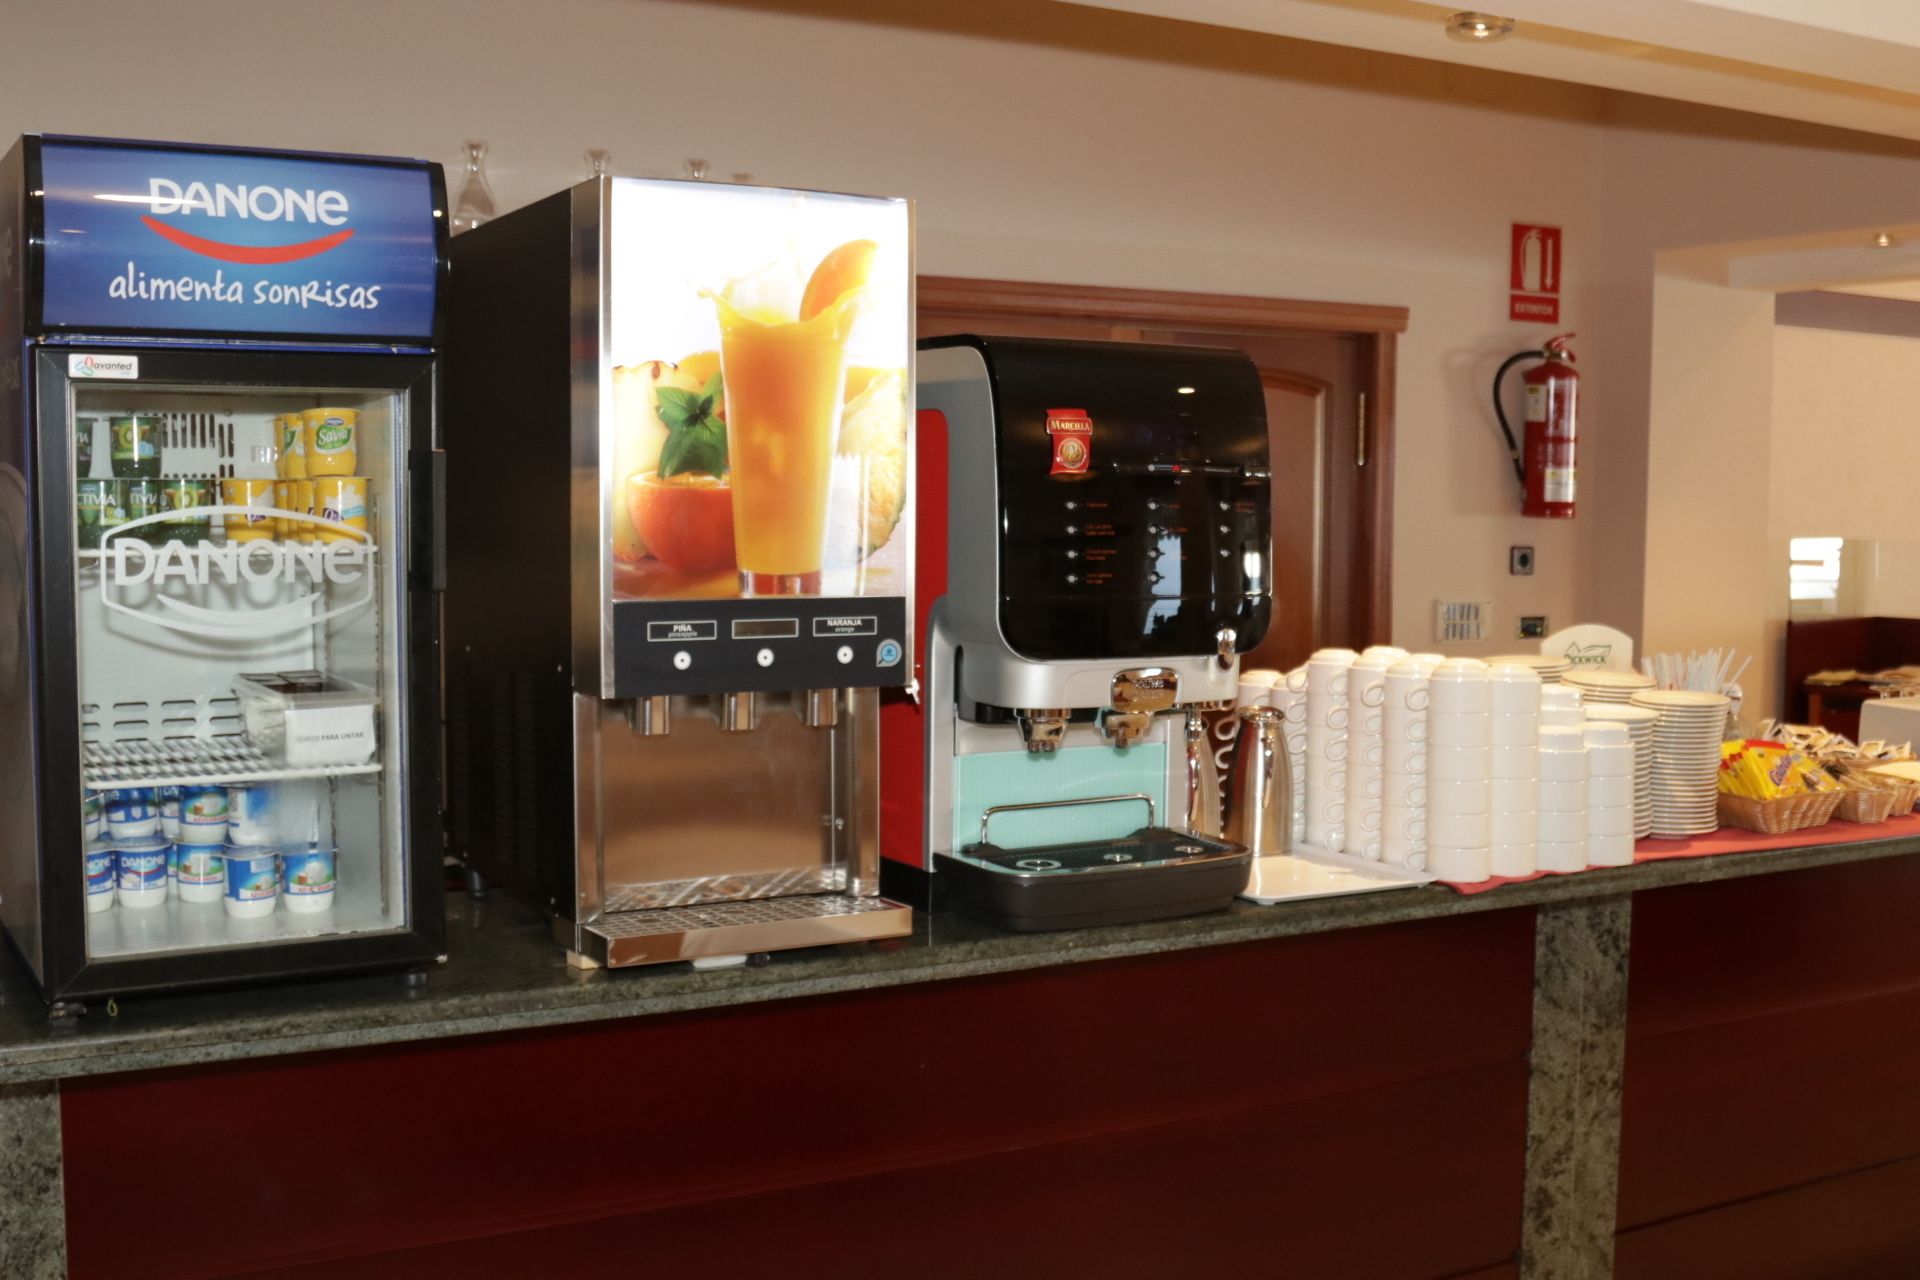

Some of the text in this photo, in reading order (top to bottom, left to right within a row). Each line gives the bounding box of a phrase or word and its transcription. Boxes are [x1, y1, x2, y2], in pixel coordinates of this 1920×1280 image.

[109, 261, 243, 304] alimenta
[827, 619, 862, 627] NARANJA
[673, 623, 692, 632] PIÑA
[321, 733, 339, 741] PARA
